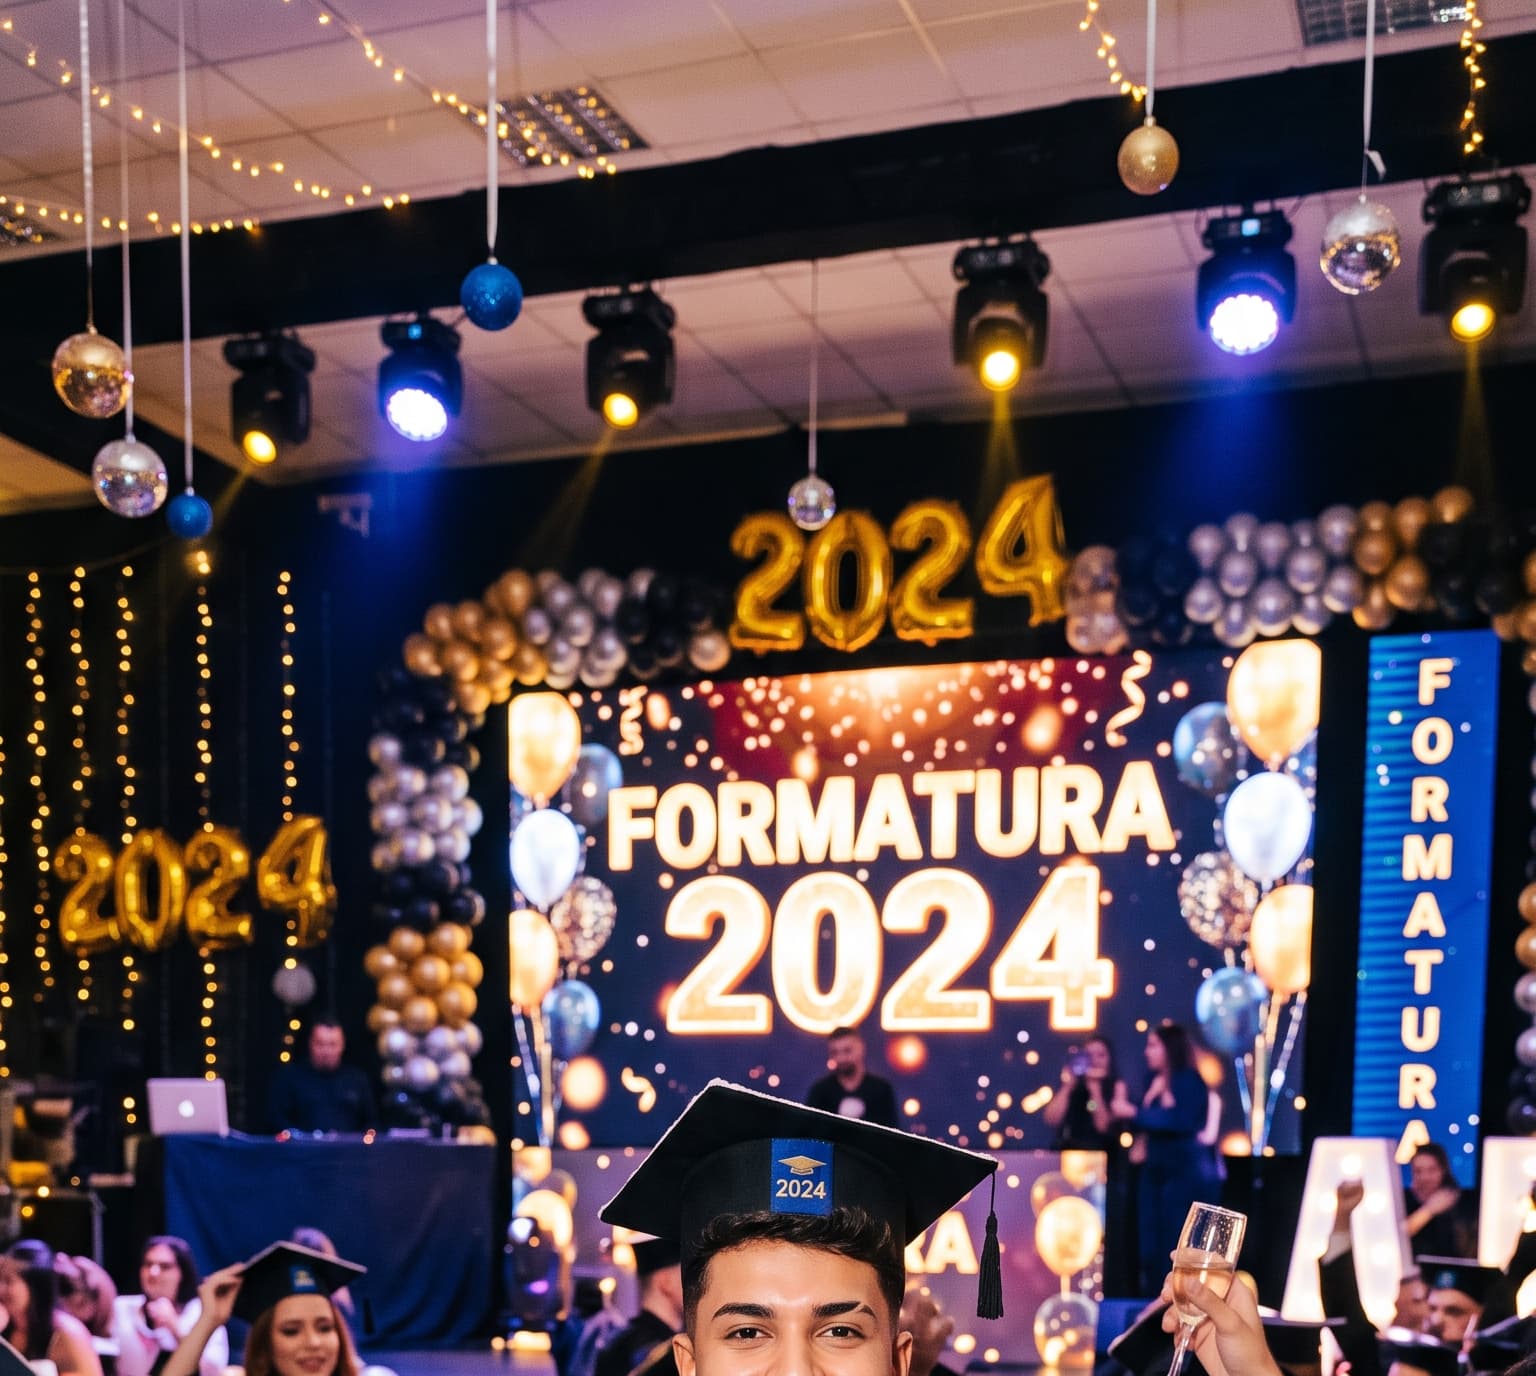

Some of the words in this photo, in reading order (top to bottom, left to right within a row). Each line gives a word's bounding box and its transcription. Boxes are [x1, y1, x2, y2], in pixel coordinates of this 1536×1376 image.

[729, 474, 1068, 652] 2024
[54, 814, 338, 951] 2024
[608, 761, 1176, 871] FORMATURA
[665, 864, 1115, 1034] 2024
[1395, 657, 1454, 1164] FORMATURA
[775, 1178, 827, 1199] 2024
